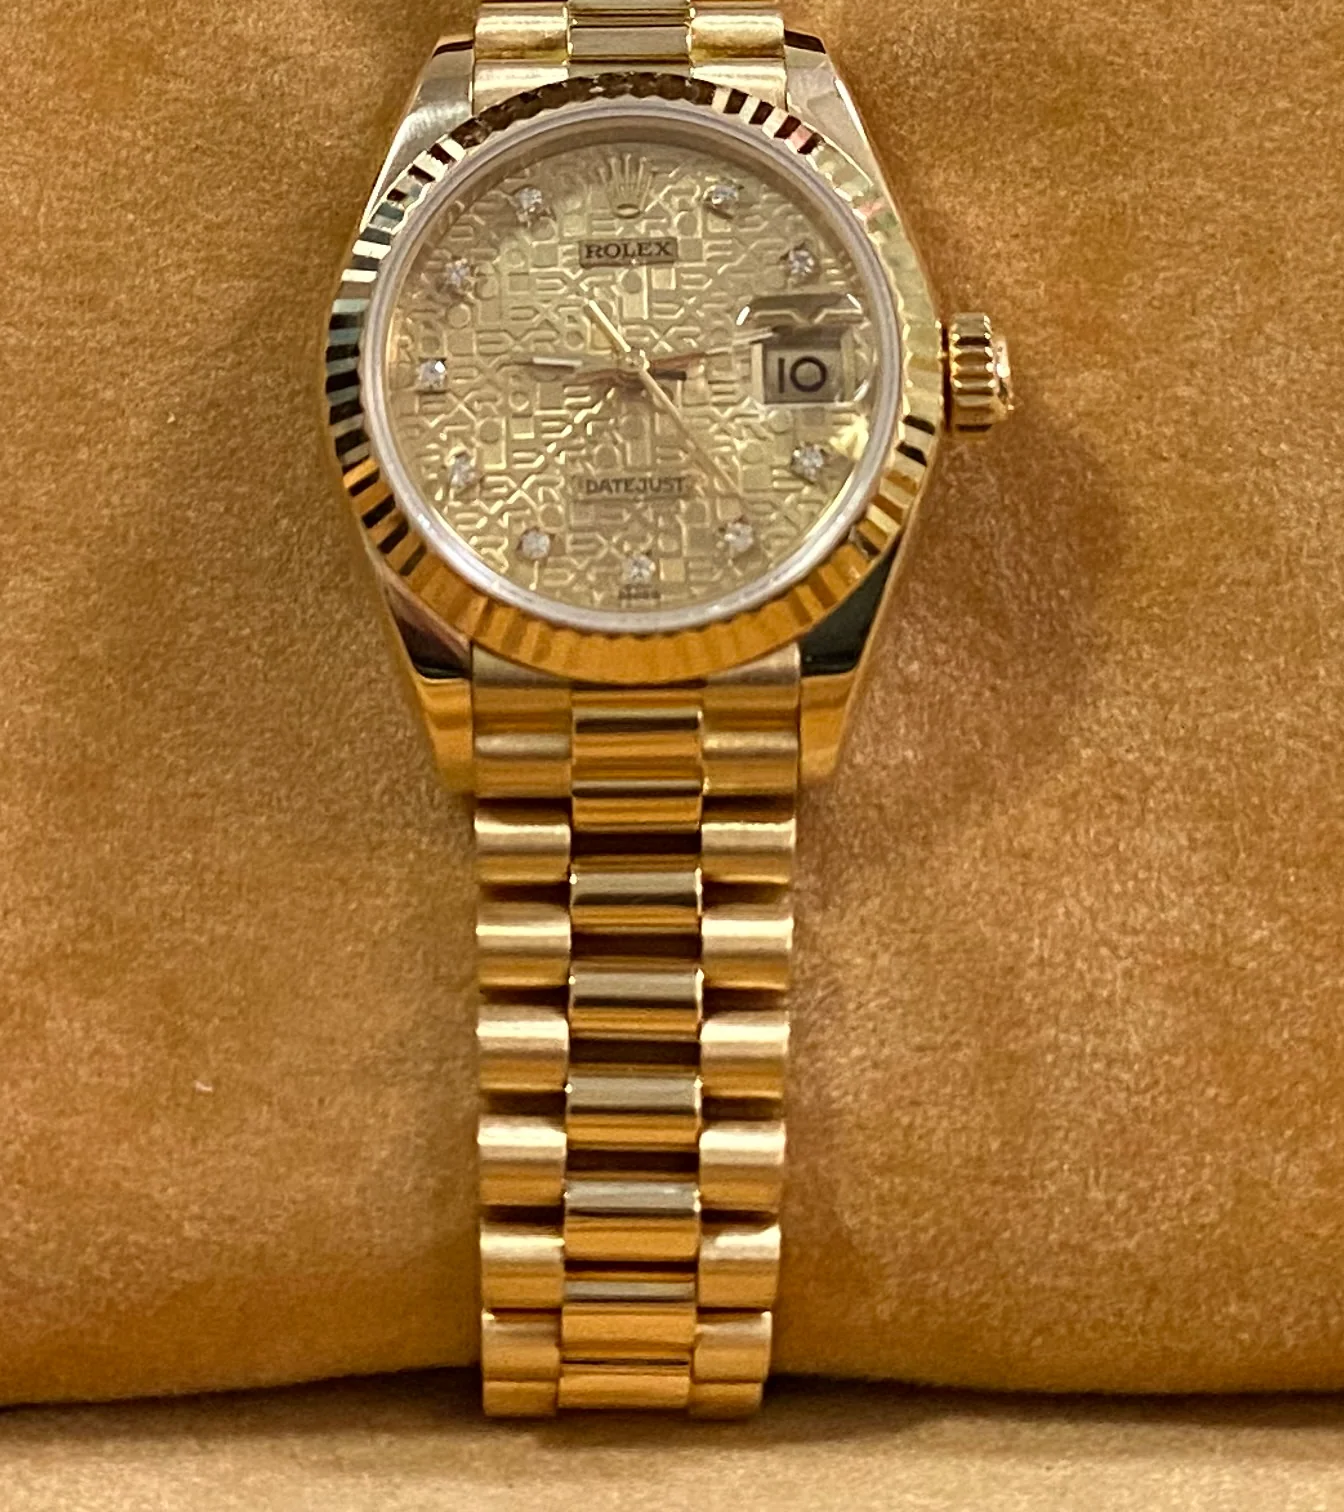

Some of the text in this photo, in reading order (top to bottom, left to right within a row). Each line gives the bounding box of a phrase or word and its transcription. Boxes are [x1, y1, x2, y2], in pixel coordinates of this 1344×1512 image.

[584, 240, 673, 260] ROLEX
[777, 355, 828, 394] 10
[585, 475, 686, 495] DATEJUST
